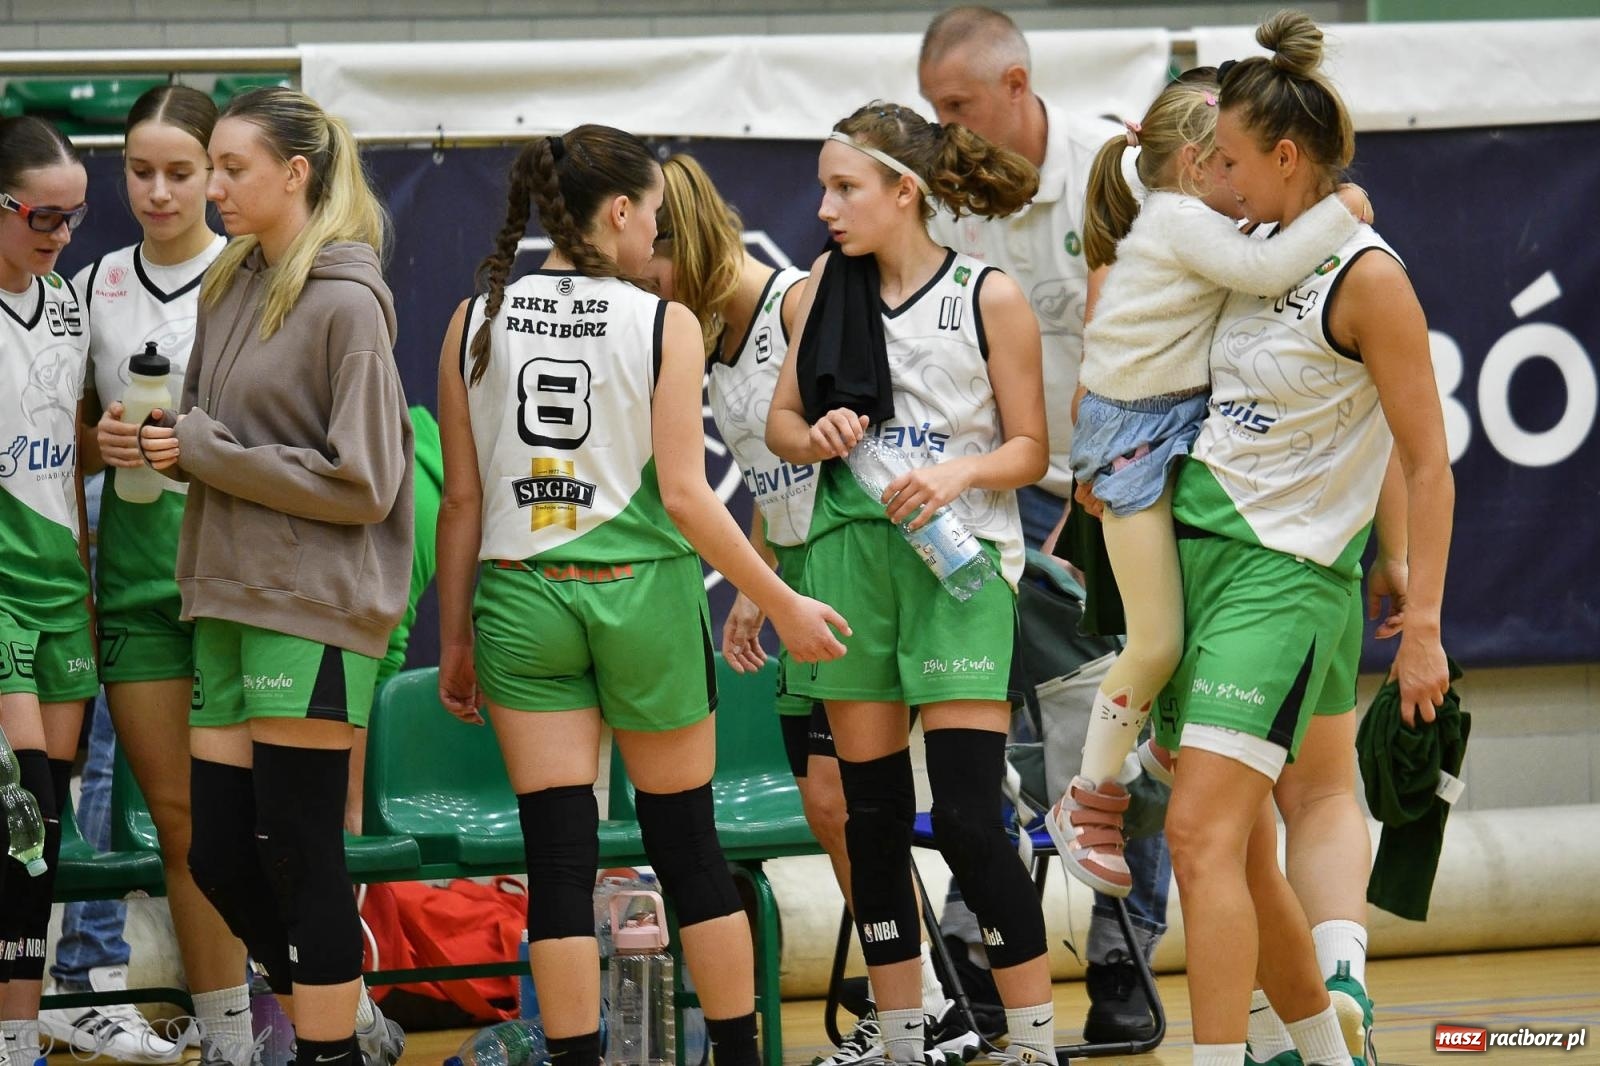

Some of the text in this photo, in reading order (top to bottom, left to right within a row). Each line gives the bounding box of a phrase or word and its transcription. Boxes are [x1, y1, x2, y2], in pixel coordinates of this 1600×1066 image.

[511, 297, 609, 314] RKK AZS
[506, 316, 608, 338] RACIBÓRZ
[517, 357, 591, 450] 8
[519, 481, 590, 501] SEGET
[873, 920, 900, 942] NBA
[26, 938, 46, 957] NBA
